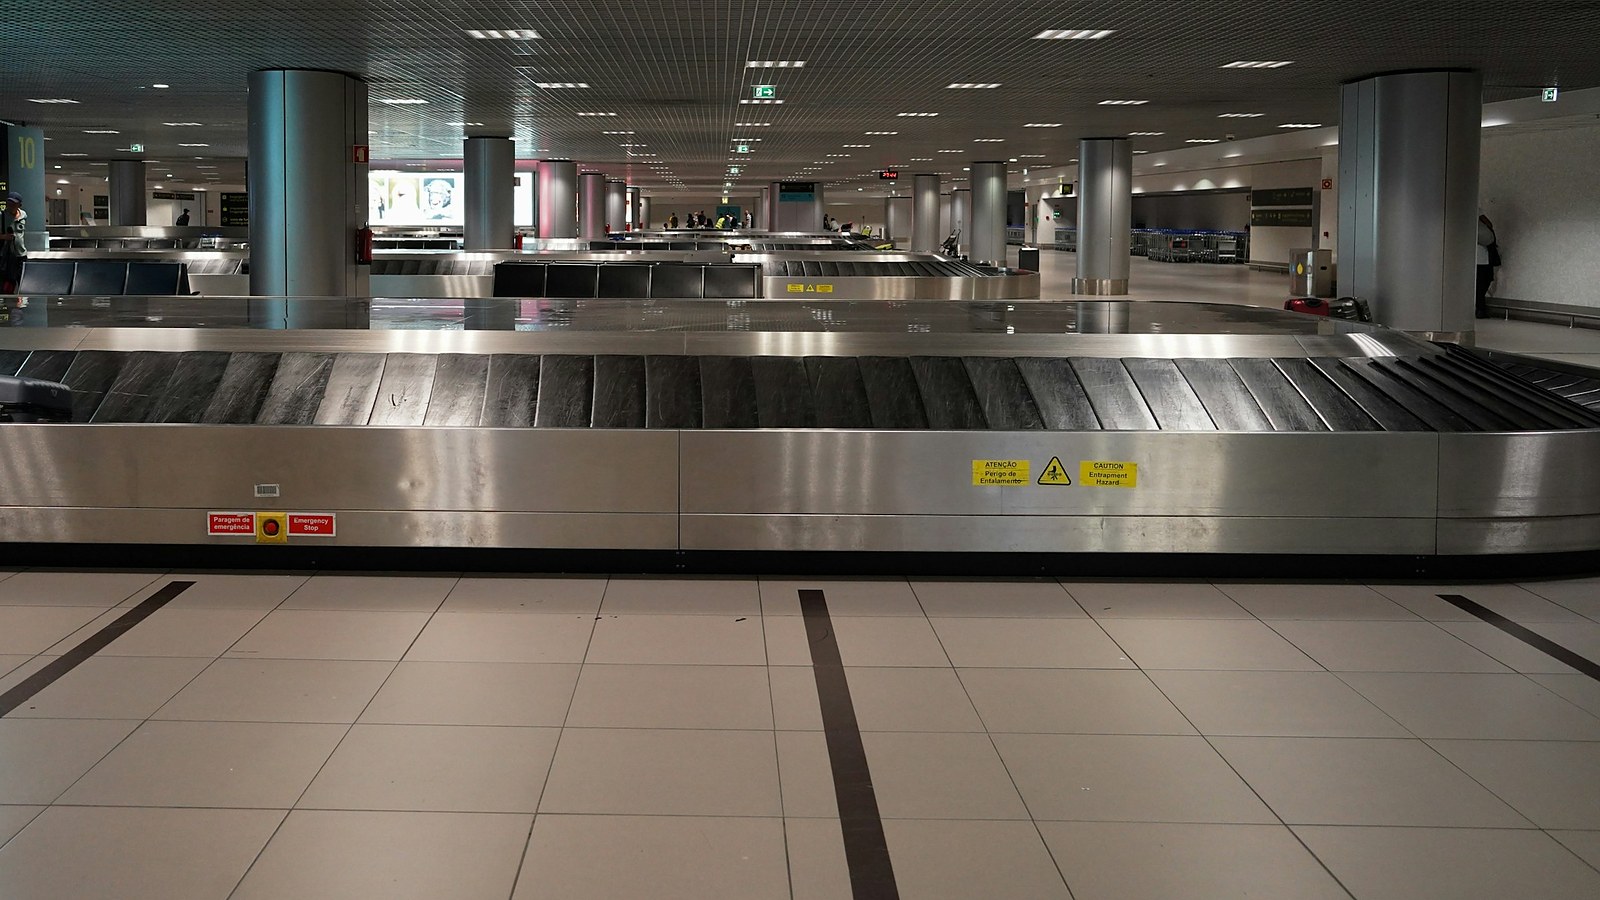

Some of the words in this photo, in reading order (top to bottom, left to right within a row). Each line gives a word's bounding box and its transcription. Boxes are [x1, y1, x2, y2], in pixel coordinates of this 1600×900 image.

[18, 136, 35, 169] 10
[985, 461, 1017, 469] ATENÇÃO
[1093, 462, 1124, 470] CAUTION
[985, 470, 1007, 478] Perigo
[213, 516, 241, 525] Paragem
[293, 517, 329, 525] Emergency
[213, 524, 250, 532] emergência
